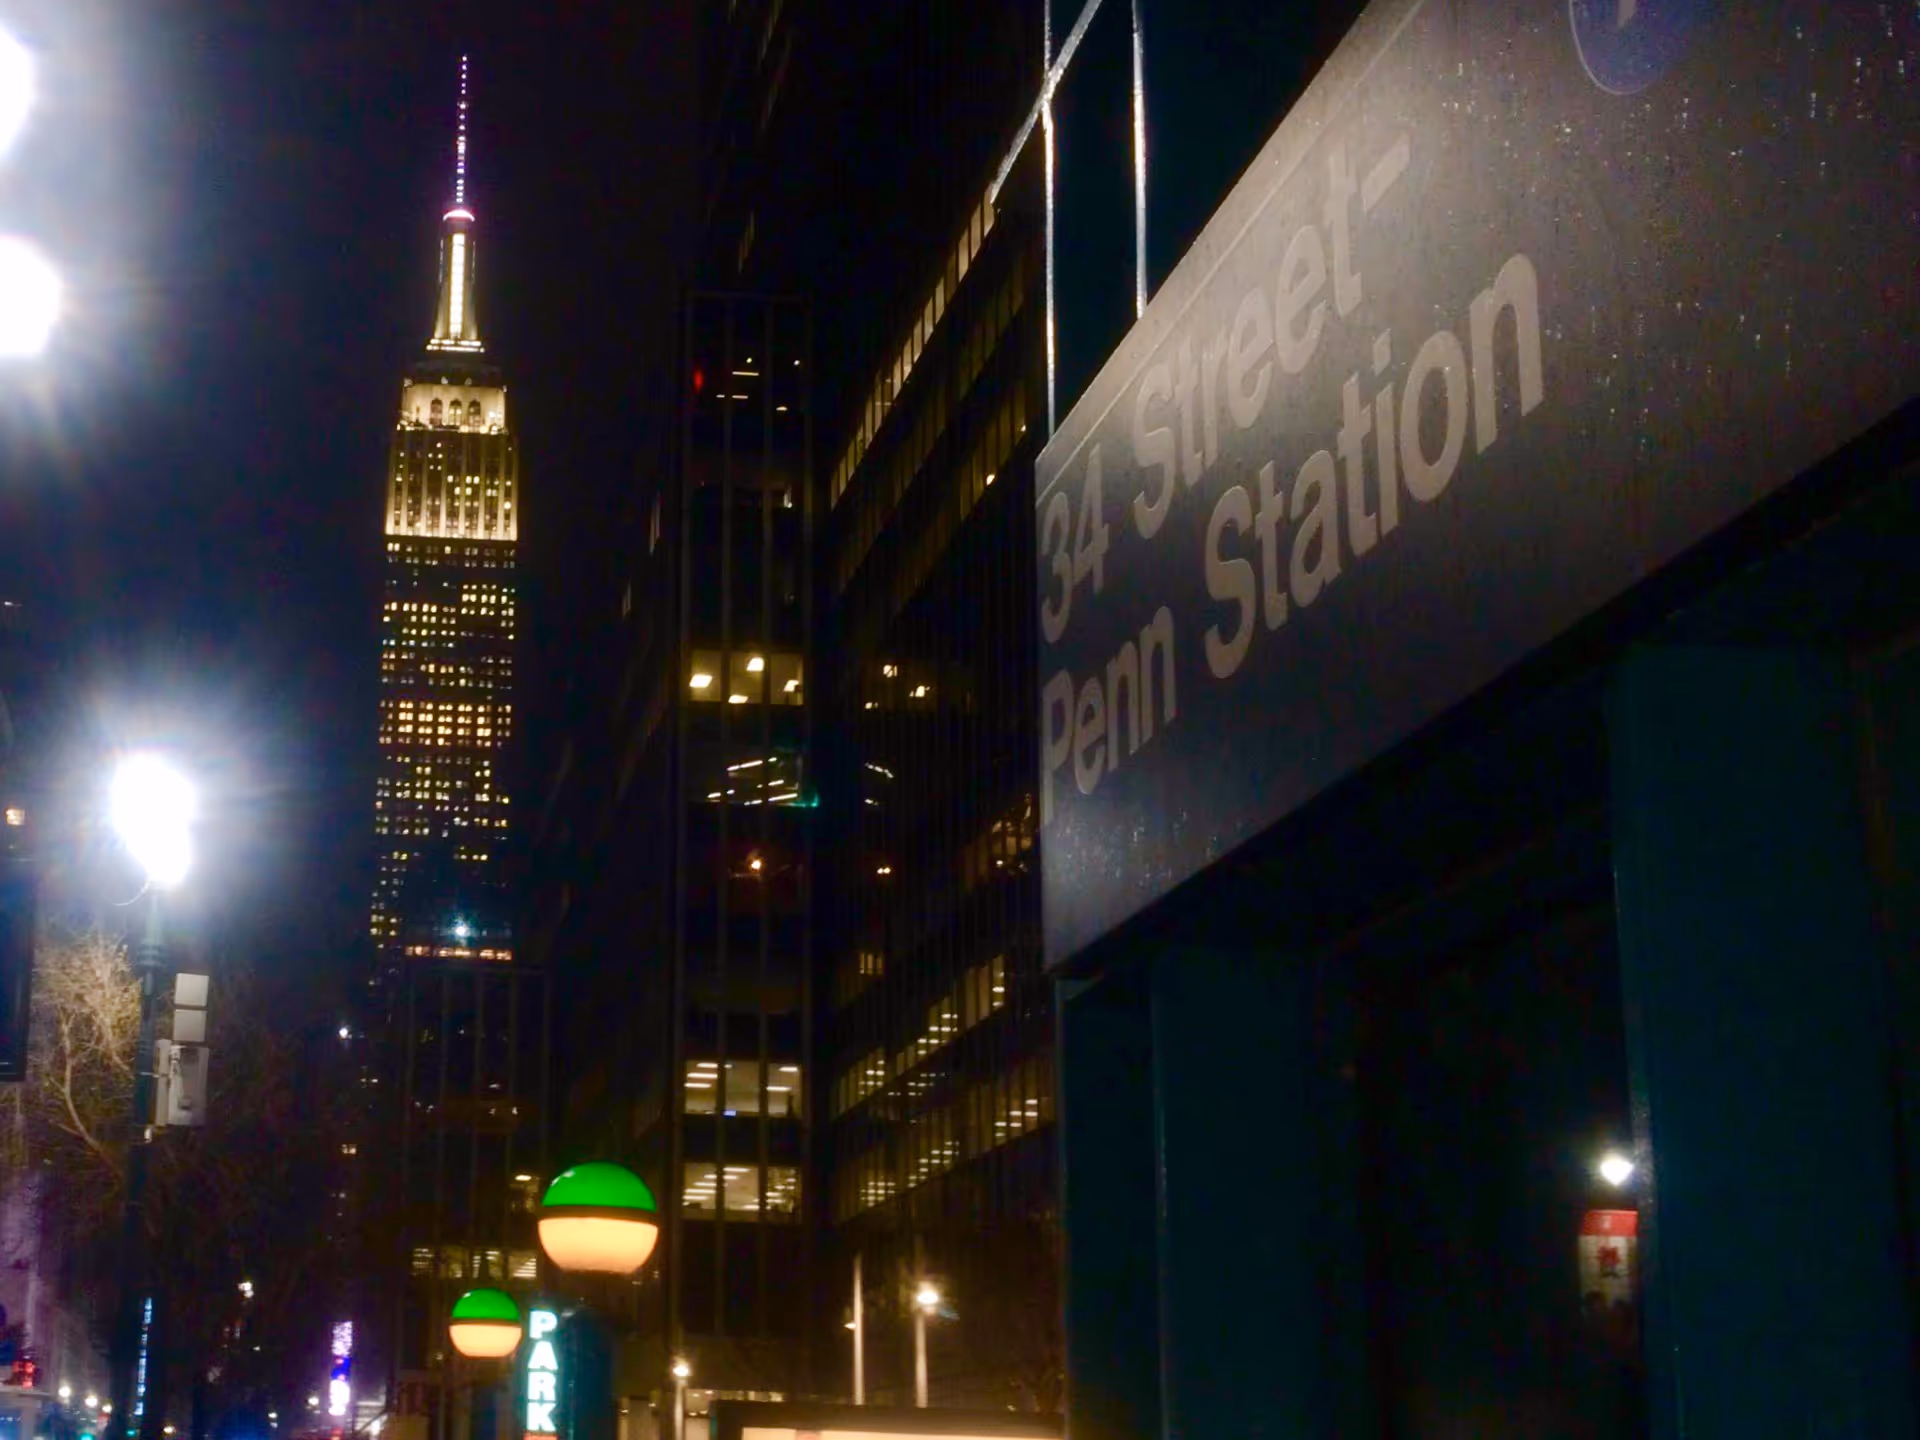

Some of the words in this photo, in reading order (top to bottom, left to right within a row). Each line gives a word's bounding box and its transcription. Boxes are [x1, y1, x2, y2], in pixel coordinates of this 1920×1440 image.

[1041, 442, 1110, 643] 34
[1133, 131, 1411, 539] Street-
[1042, 668, 1177, 827] Penn
[1204, 252, 1544, 679] Station
[526, 1309, 559, 1432] PARK
